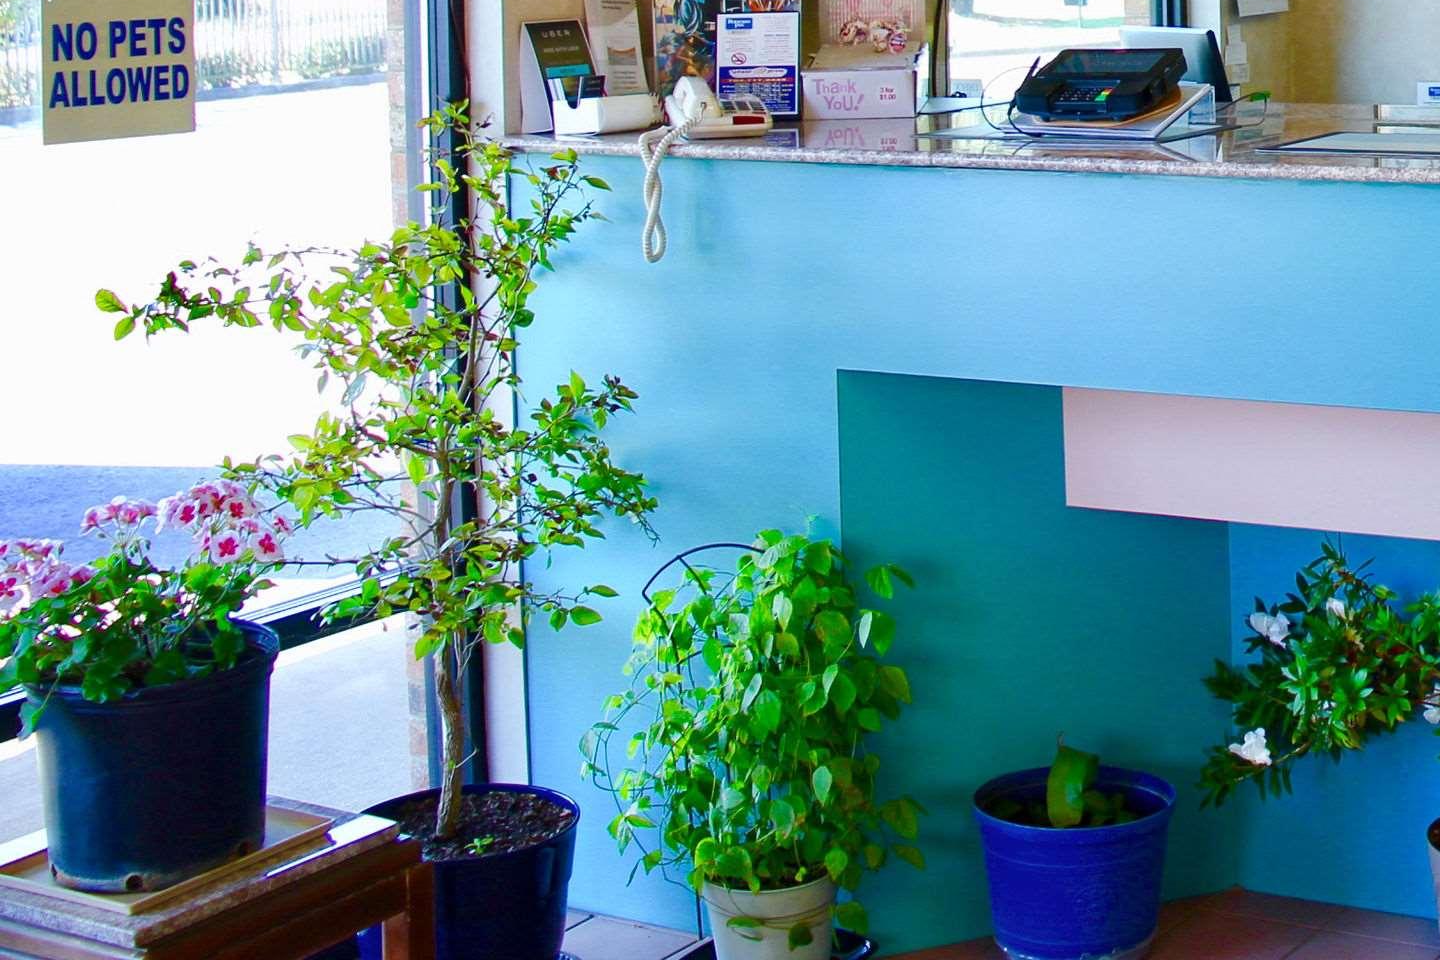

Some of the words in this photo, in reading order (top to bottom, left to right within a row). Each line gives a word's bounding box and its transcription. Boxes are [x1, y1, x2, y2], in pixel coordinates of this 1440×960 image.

[52, 22, 97, 61] NO
[109, 17, 186, 58] PETS
[49, 64, 190, 109] ALLOWED
[812, 78, 857, 96] Thank
